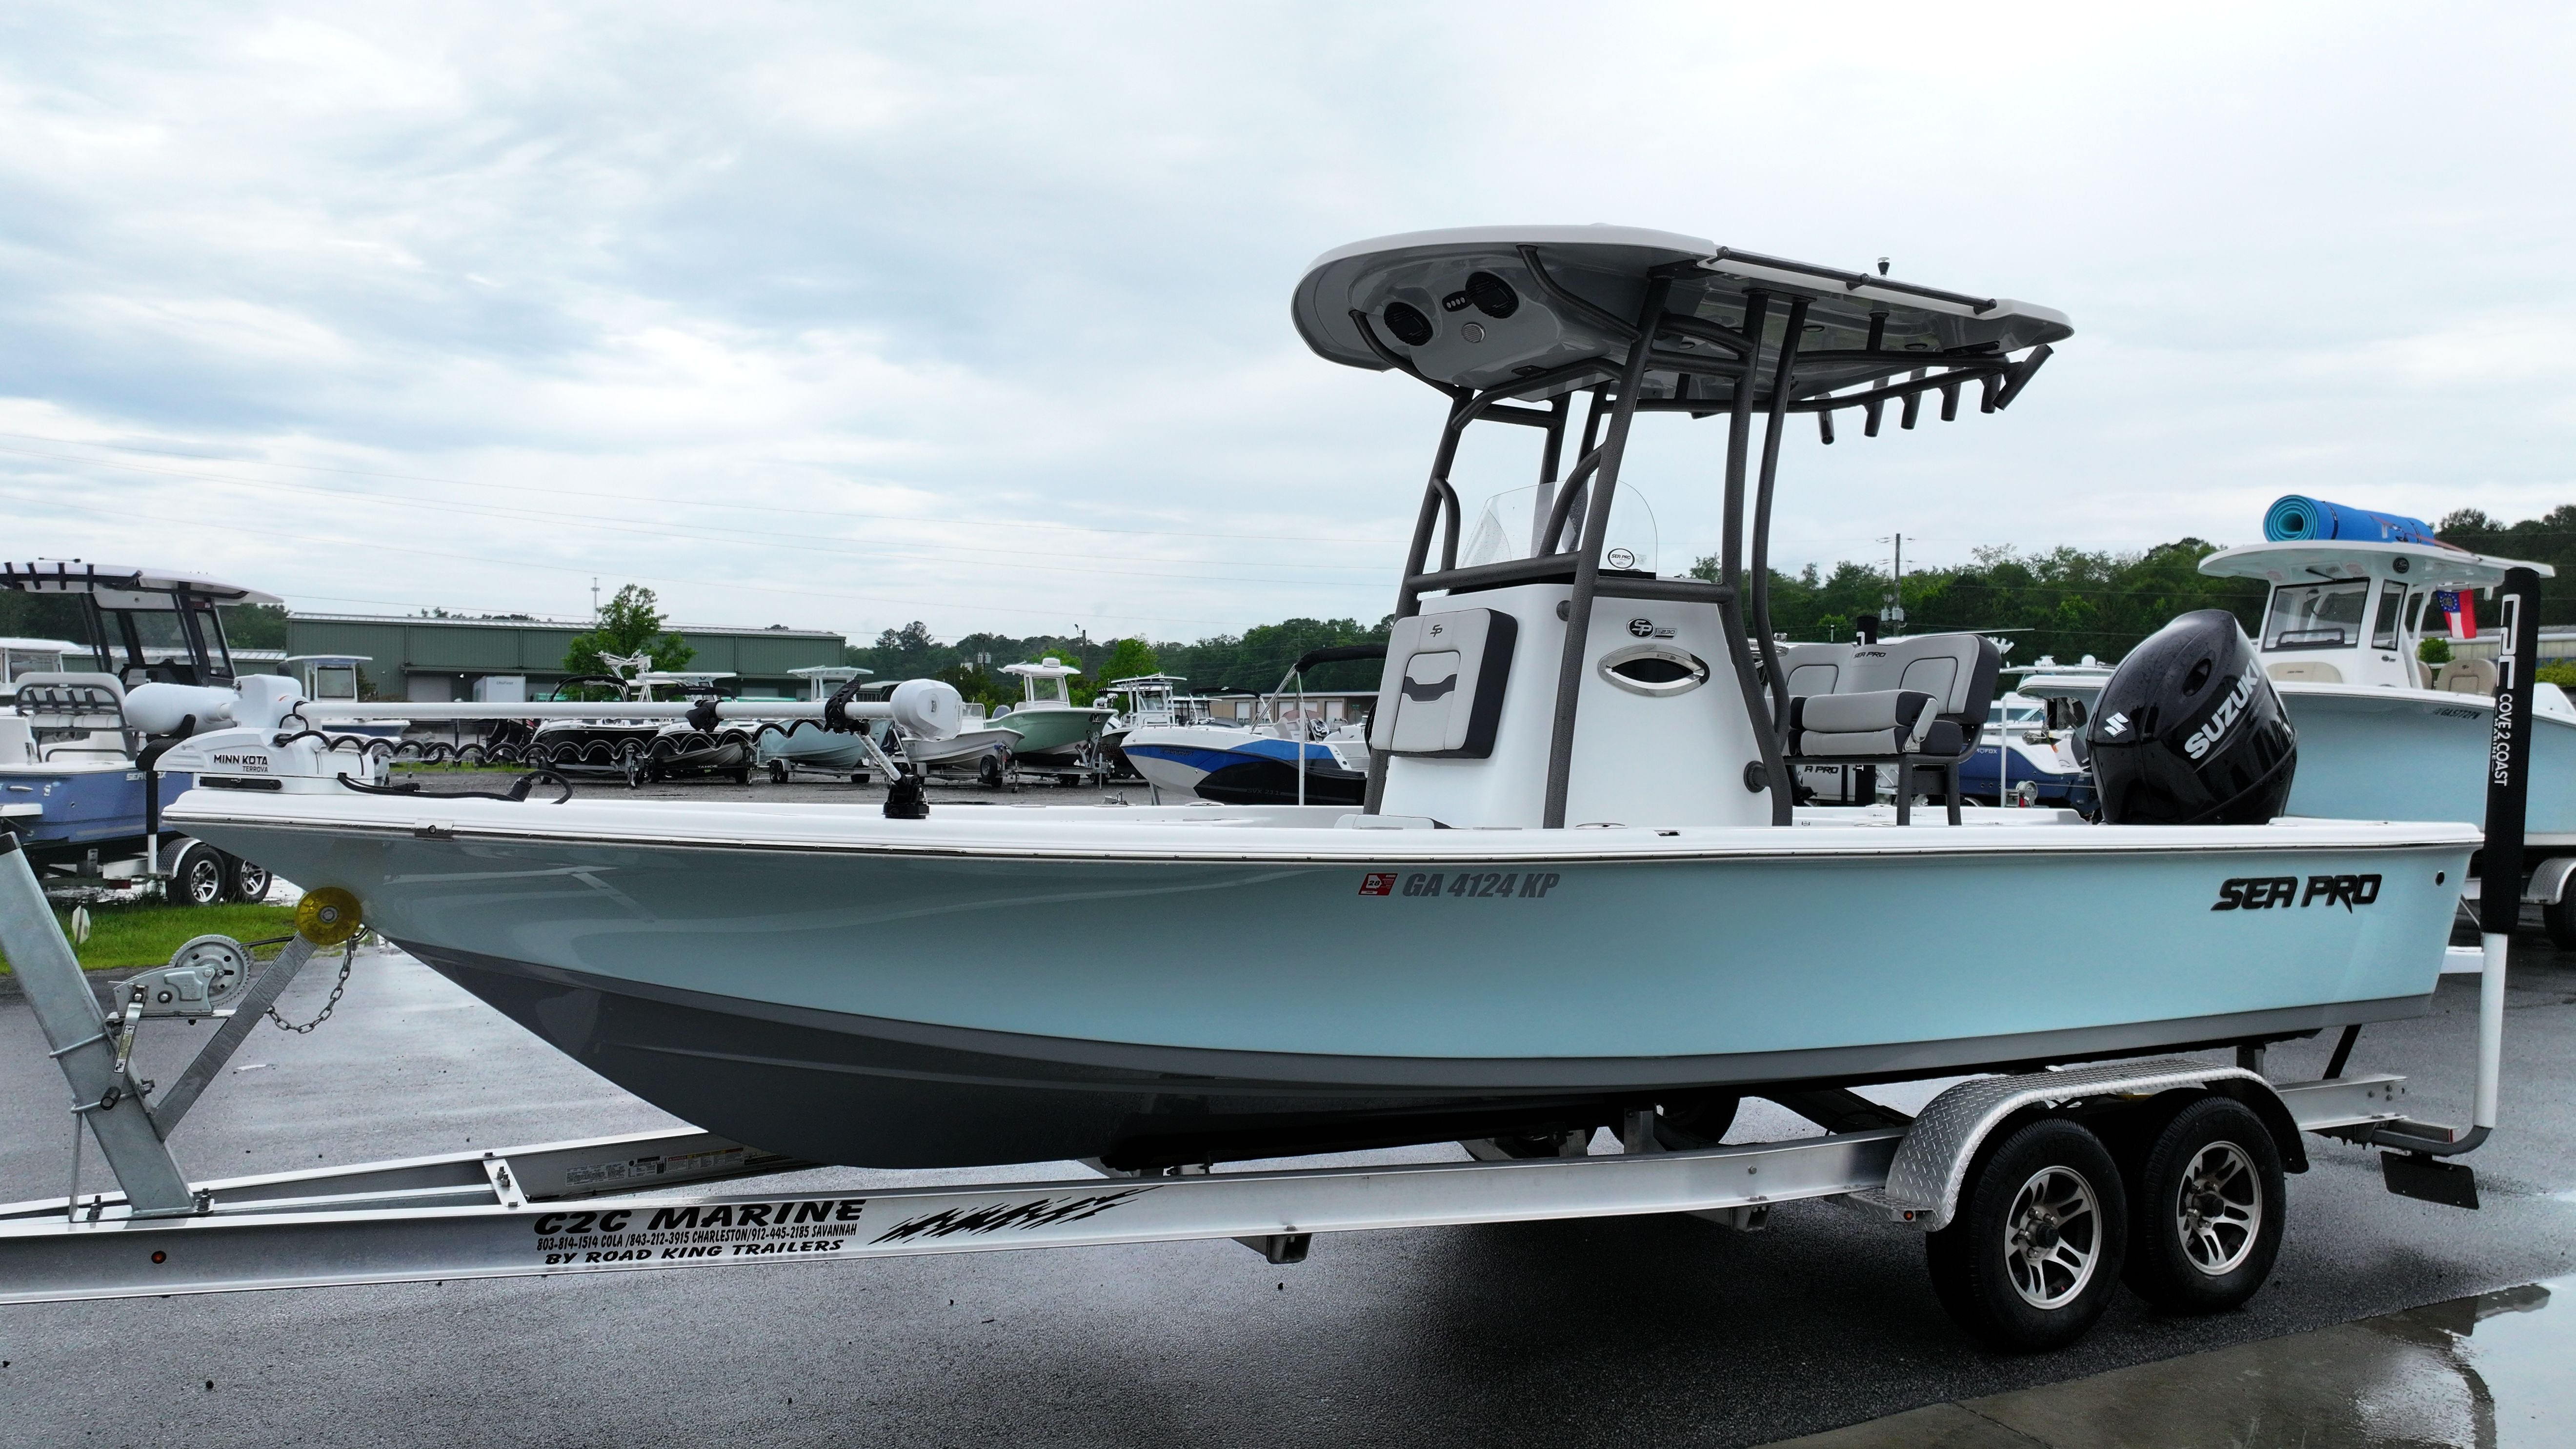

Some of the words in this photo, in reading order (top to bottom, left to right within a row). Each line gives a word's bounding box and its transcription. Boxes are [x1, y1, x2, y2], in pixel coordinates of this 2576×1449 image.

[2184, 658, 2261, 759] SUZUKI
[2498, 693, 2513, 729] COVE
[214, 754, 240, 764] MINN
[242, 755, 268, 765] KOTA
[1815, 766, 1839, 775] PRO
[2494, 743, 2510, 786] COAST
[1402, 873, 1444, 897] GA
[1447, 873, 1518, 897] 4124
[1518, 873, 1560, 898] KP
[2211, 876, 2298, 911] SEA
[2300, 874, 2382, 914] PRO
[534, 1210, 632, 1235] C2C
[647, 1199, 866, 1230] MARINE
[537, 1235, 598, 1251] 803-814-1514
[601, 1234, 623, 1248] COLA
[625, 1231, 689, 1248] /843-212-3915
[811, 1223, 857, 1238] SAVANNAH
[545, 1252, 578, 1265] BY
[585, 1249, 652, 1263] ROAD
[661, 1246, 723, 1259] KING
[732, 1239, 845, 1256] TRAILERS
